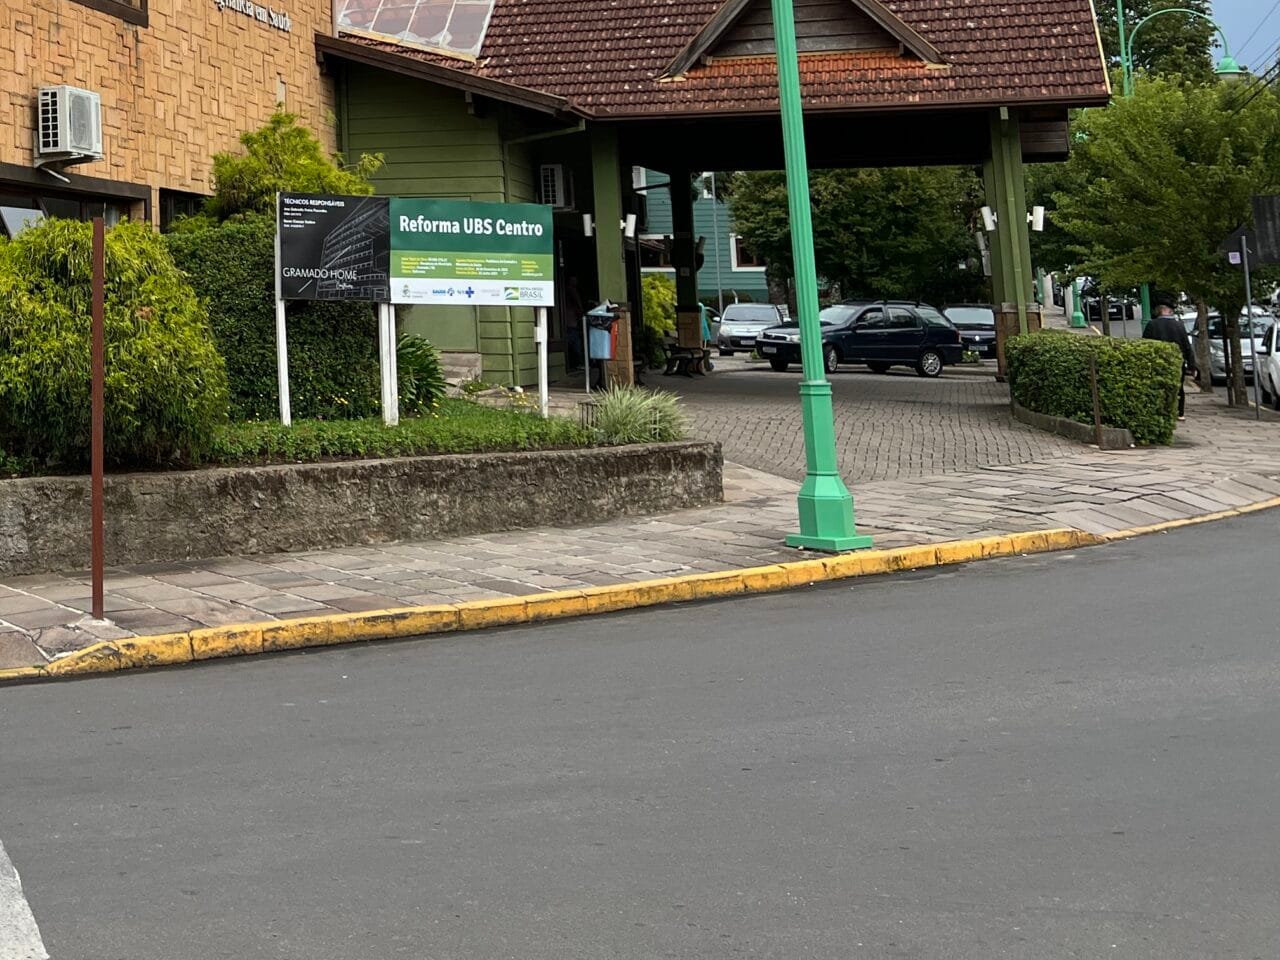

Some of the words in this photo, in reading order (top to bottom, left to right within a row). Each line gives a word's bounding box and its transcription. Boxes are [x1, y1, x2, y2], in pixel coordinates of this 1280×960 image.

[268, 3, 292, 32] Saúde
[284, 197, 309, 205] TÉCNICOS
[400, 215, 461, 234] Reforma
[463, 218, 493, 235] UBS
[496, 219, 543, 236] Centro
[282, 267, 328, 278] GRAMADO
[330, 270, 358, 280] HOME
